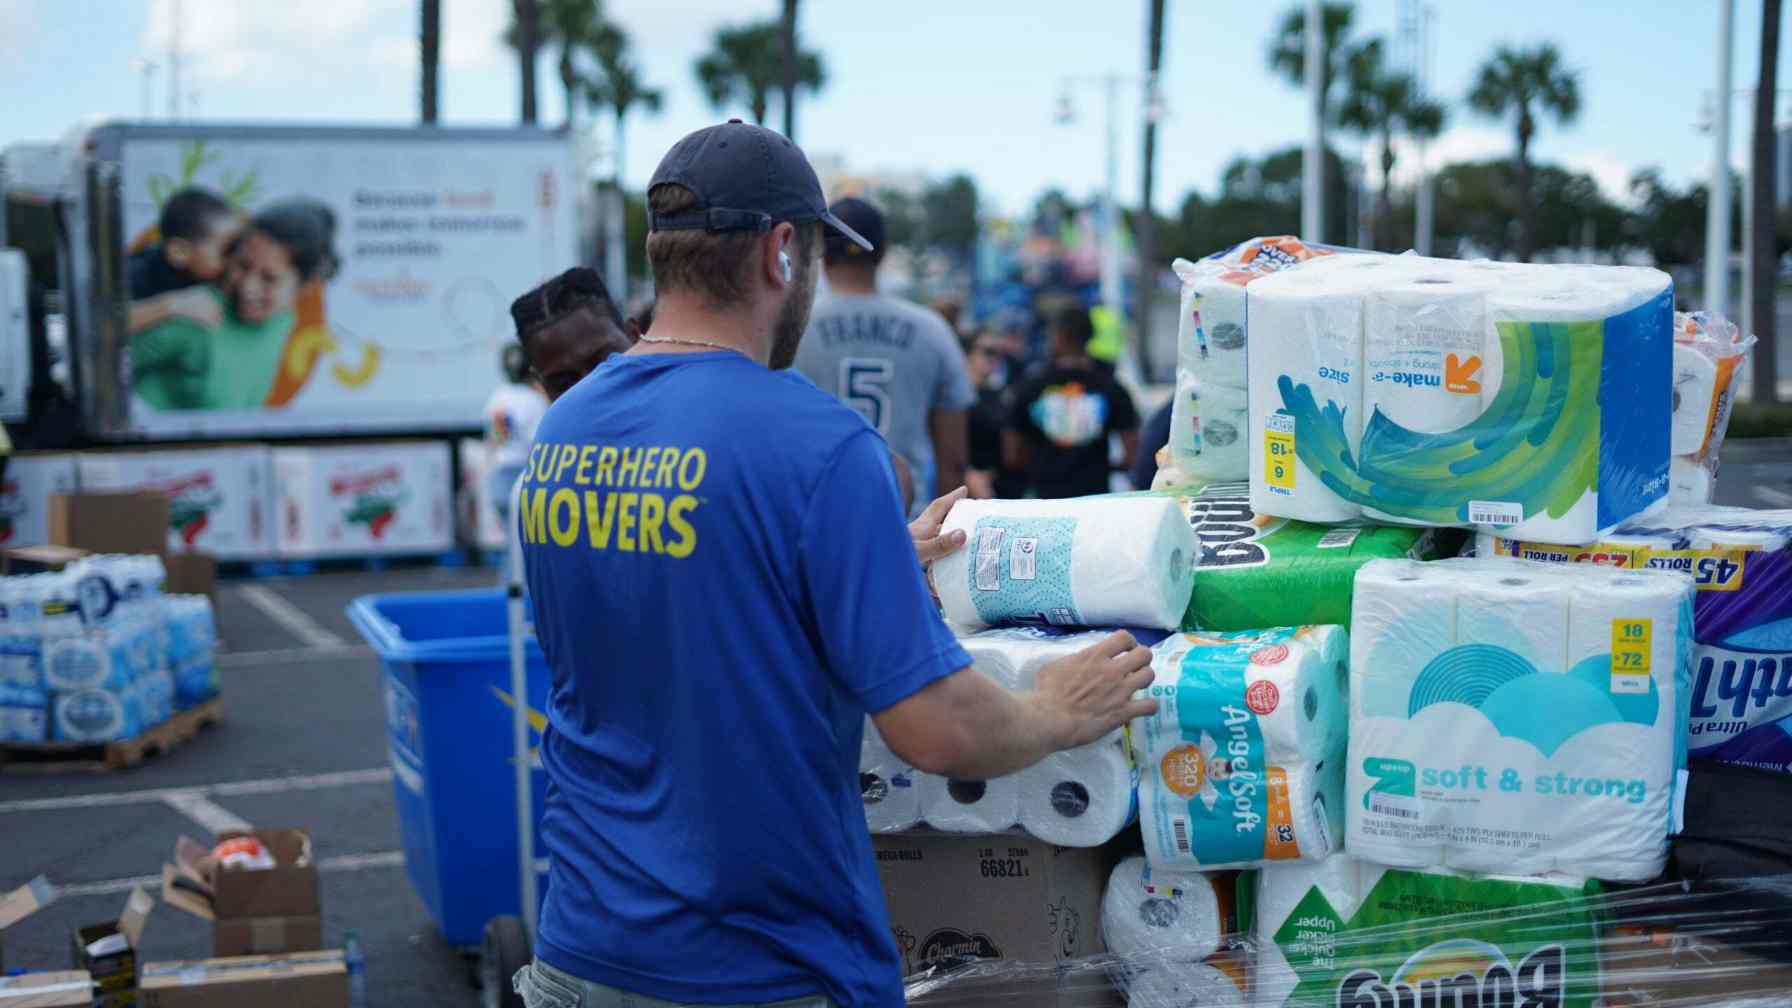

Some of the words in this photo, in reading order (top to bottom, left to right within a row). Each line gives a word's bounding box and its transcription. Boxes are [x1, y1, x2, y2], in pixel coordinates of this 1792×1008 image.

[816, 313, 917, 349] FRANCO
[839, 357, 894, 436] 5
[1271, 442, 1287, 455] 18
[524, 442, 707, 490] SUPERHERO
[1274, 466, 1285, 479] 6
[520, 487, 699, 558] MOVERS
[1523, 550, 1548, 562] ROLL
[1550, 551, 1569, 563] PER
[1694, 557, 1740, 585] 45
[1623, 623, 1643, 638] 18
[1621, 650, 1643, 667] 72
[1706, 720, 1748, 736] Ultra
[1183, 754, 1199, 788] 320
[1421, 765, 1488, 791] soft
[1498, 767, 1522, 793] &
[1535, 770, 1647, 804] strong
[1277, 824, 1294, 843] 32
[980, 858, 1024, 878] 66821
[1296, 915, 1335, 931] Upper
[925, 937, 981, 962] Charmin
[1311, 957, 1335, 970] The
